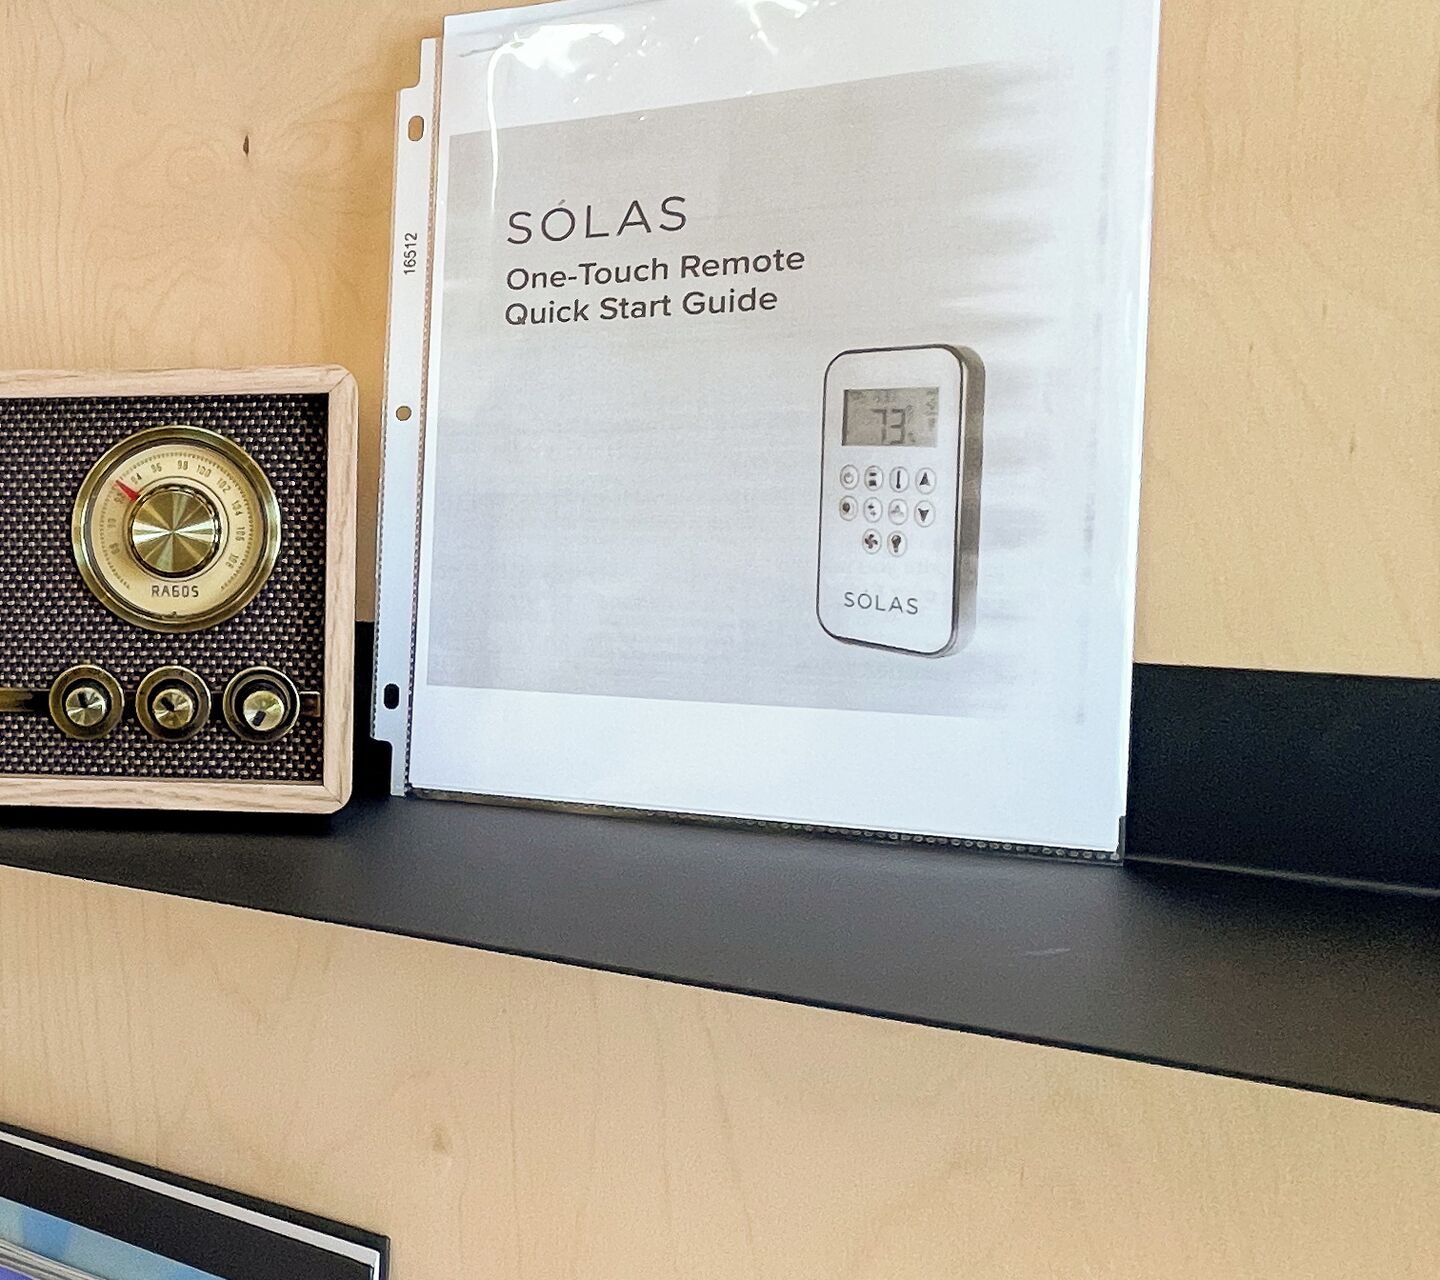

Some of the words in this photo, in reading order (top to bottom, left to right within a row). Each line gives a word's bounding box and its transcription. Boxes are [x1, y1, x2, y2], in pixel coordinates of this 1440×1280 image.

[402, 231, 419, 275] 16512
[506, 257, 670, 291] One-Touch
[680, 248, 806, 279] Remote
[504, 299, 590, 326] Quick
[599, 293, 672, 320] Start
[681, 287, 779, 316] Guide
